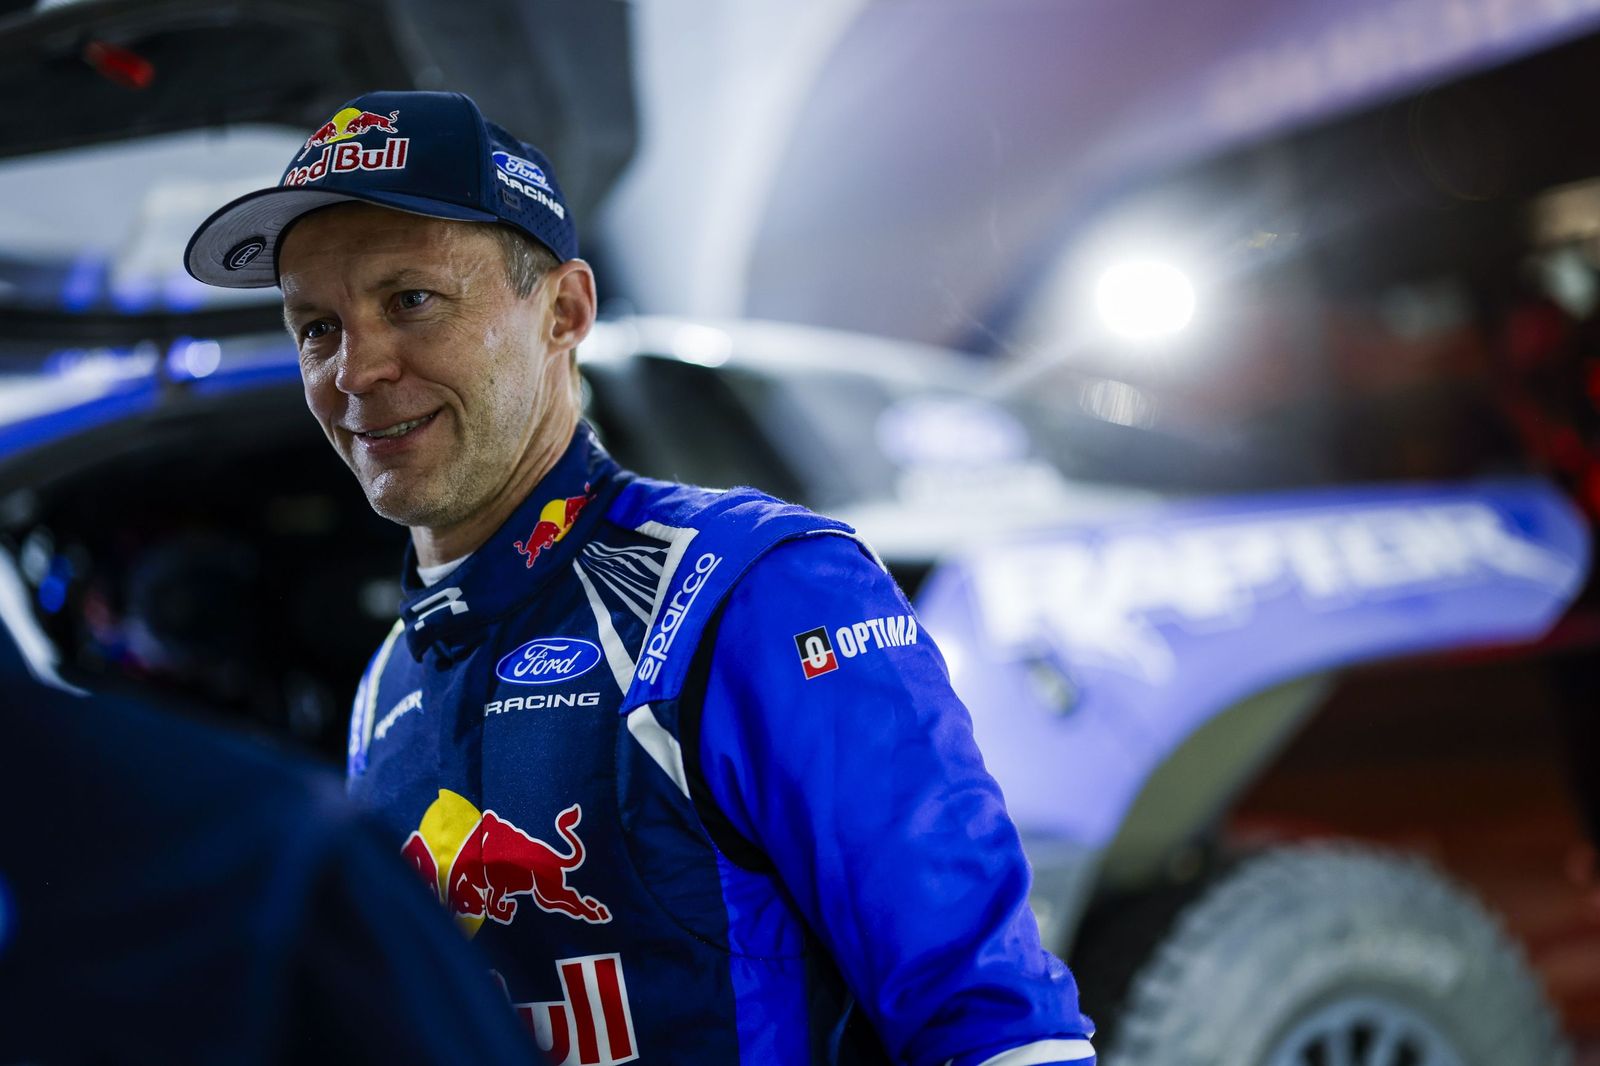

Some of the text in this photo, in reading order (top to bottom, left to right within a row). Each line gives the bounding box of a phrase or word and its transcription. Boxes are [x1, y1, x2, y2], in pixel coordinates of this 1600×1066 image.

[331, 137, 410, 173] Bull
[505, 157, 547, 187] Ford
[496, 169, 564, 220] RACING
[637, 552, 723, 686] sparco
[835, 615, 918, 658] OPTIMA
[513, 644, 582, 677] Ford
[483, 692, 600, 717] RACING
[490, 952, 640, 1066] ull
